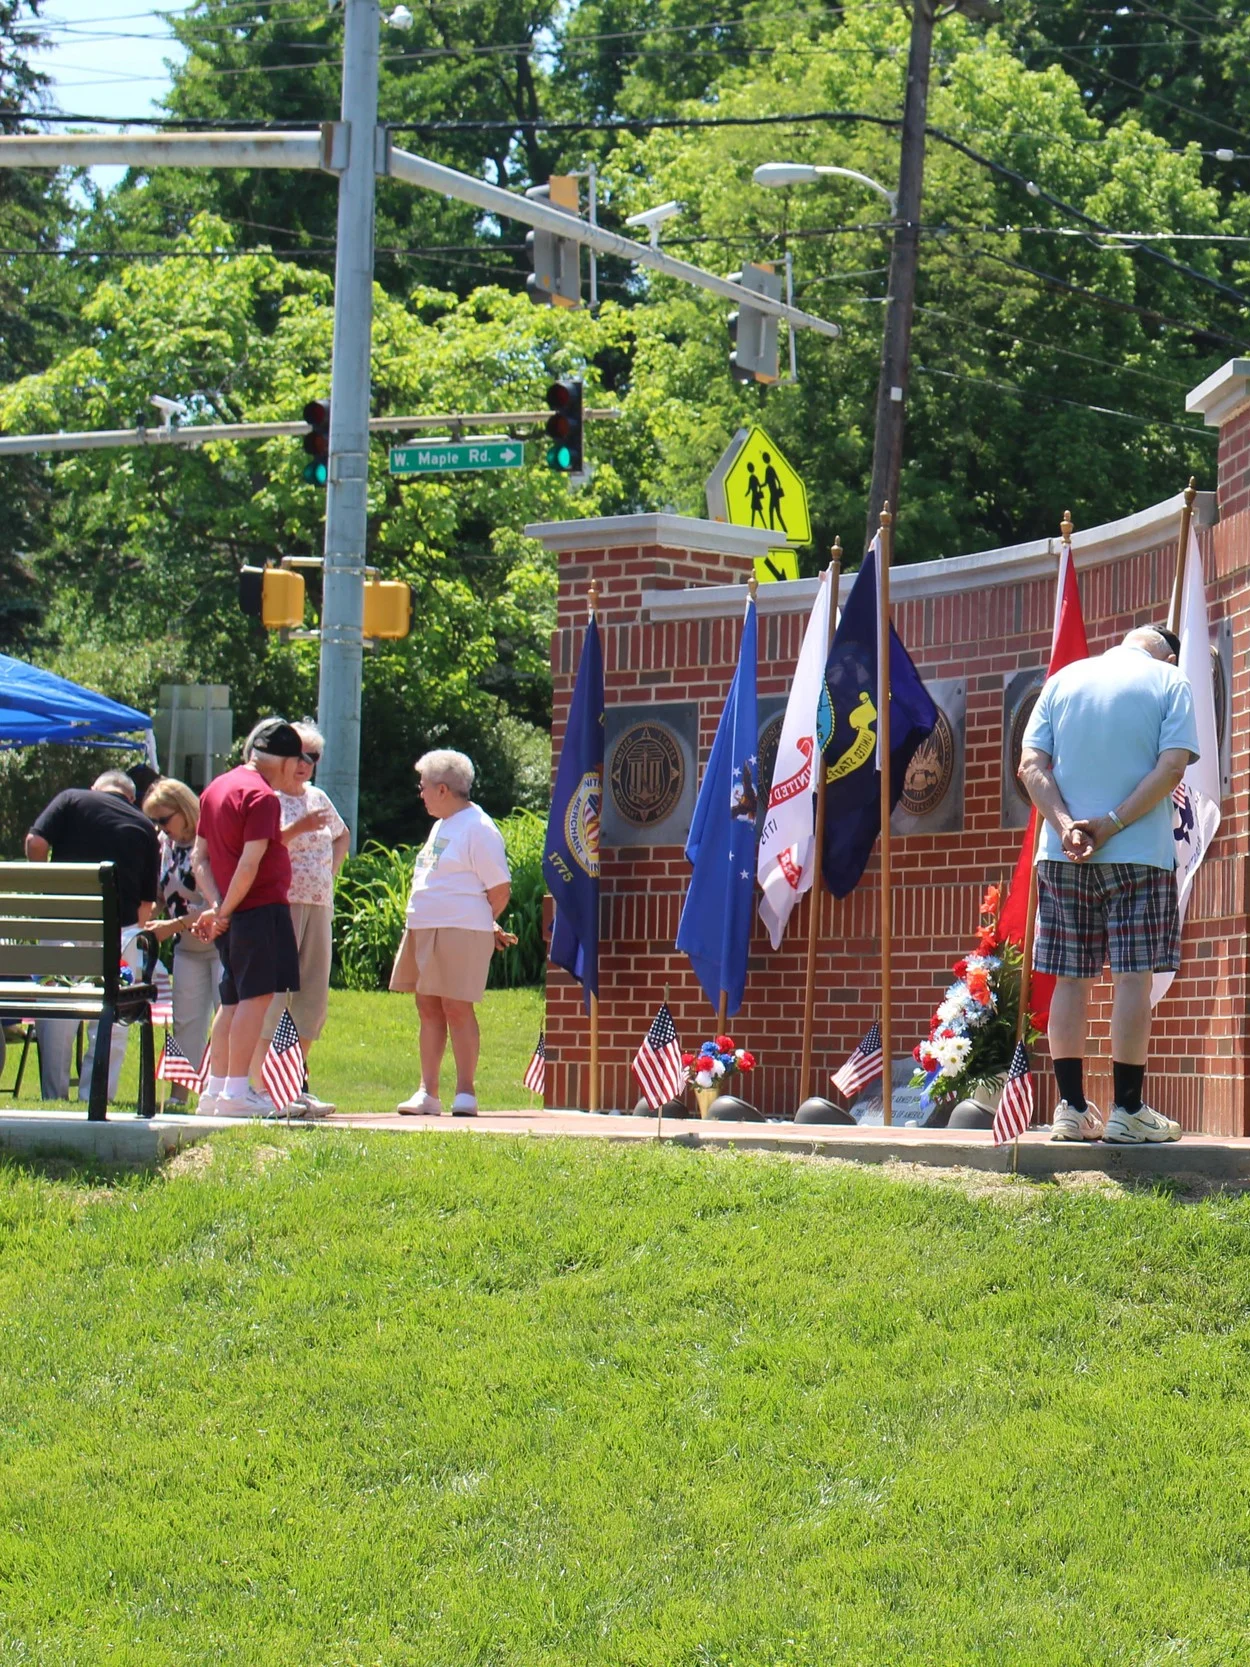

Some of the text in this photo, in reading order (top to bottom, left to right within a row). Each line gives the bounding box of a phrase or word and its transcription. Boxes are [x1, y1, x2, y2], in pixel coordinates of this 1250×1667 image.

[394, 449, 491, 467] W. Maple Rd.
[570, 796, 583, 855] MERCHANT
[548, 851, 574, 882] 1775
